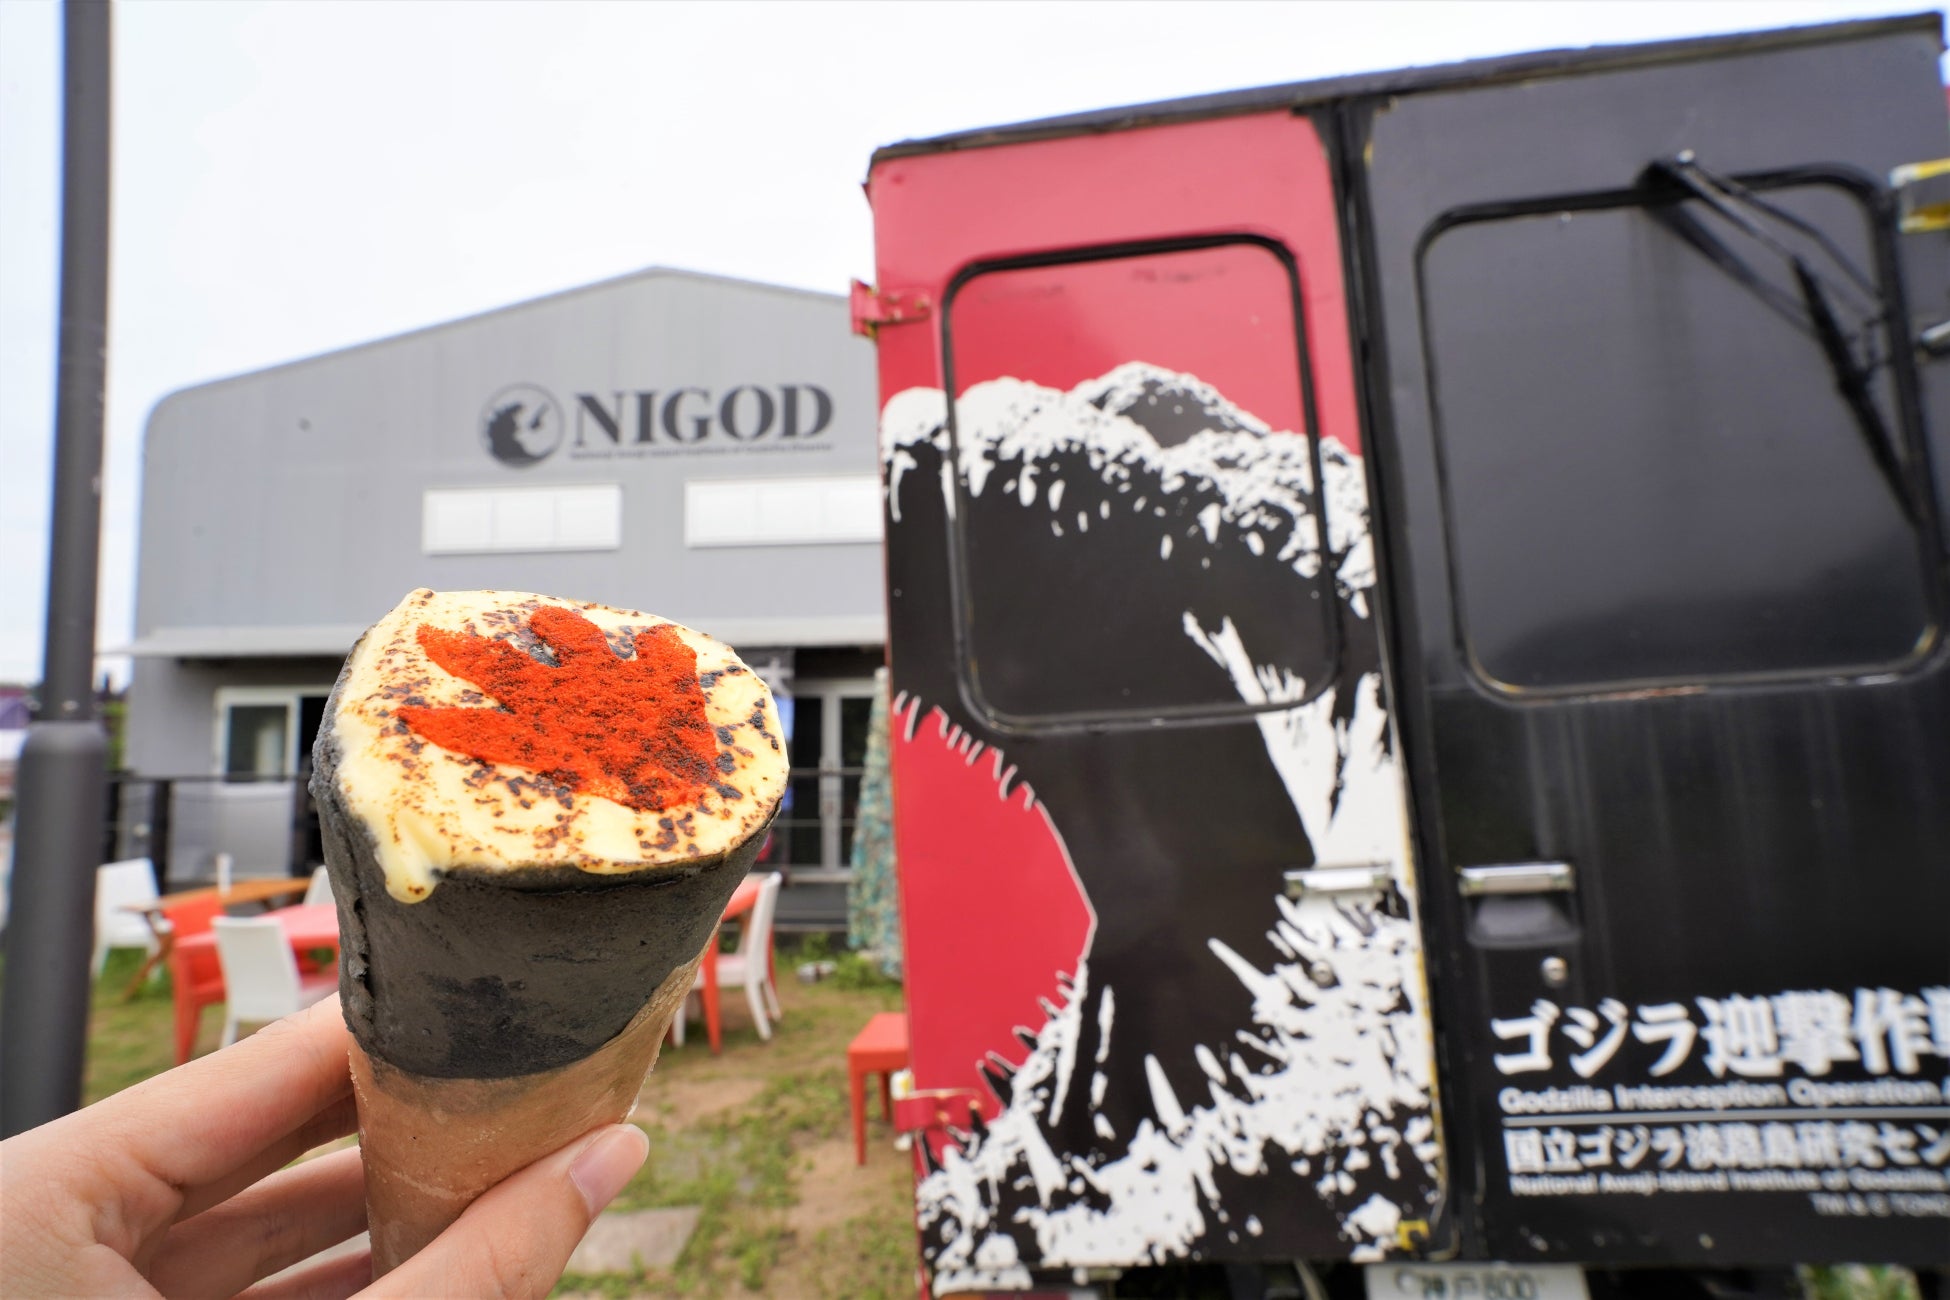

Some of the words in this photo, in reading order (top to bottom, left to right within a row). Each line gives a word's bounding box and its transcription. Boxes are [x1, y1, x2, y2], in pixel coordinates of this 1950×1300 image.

[572, 383, 834, 447] NIGOD
[1499, 1085, 1613, 1115] Godzilla
[1614, 1080, 1787, 1111] Interception
[1787, 1076, 1942, 1108] Operation
[1509, 1172, 1599, 1196] National
[1728, 1168, 1821, 1191] Institute
[1820, 1167, 1850, 1191] of
[1848, 1166, 1946, 1191] Godzilla
